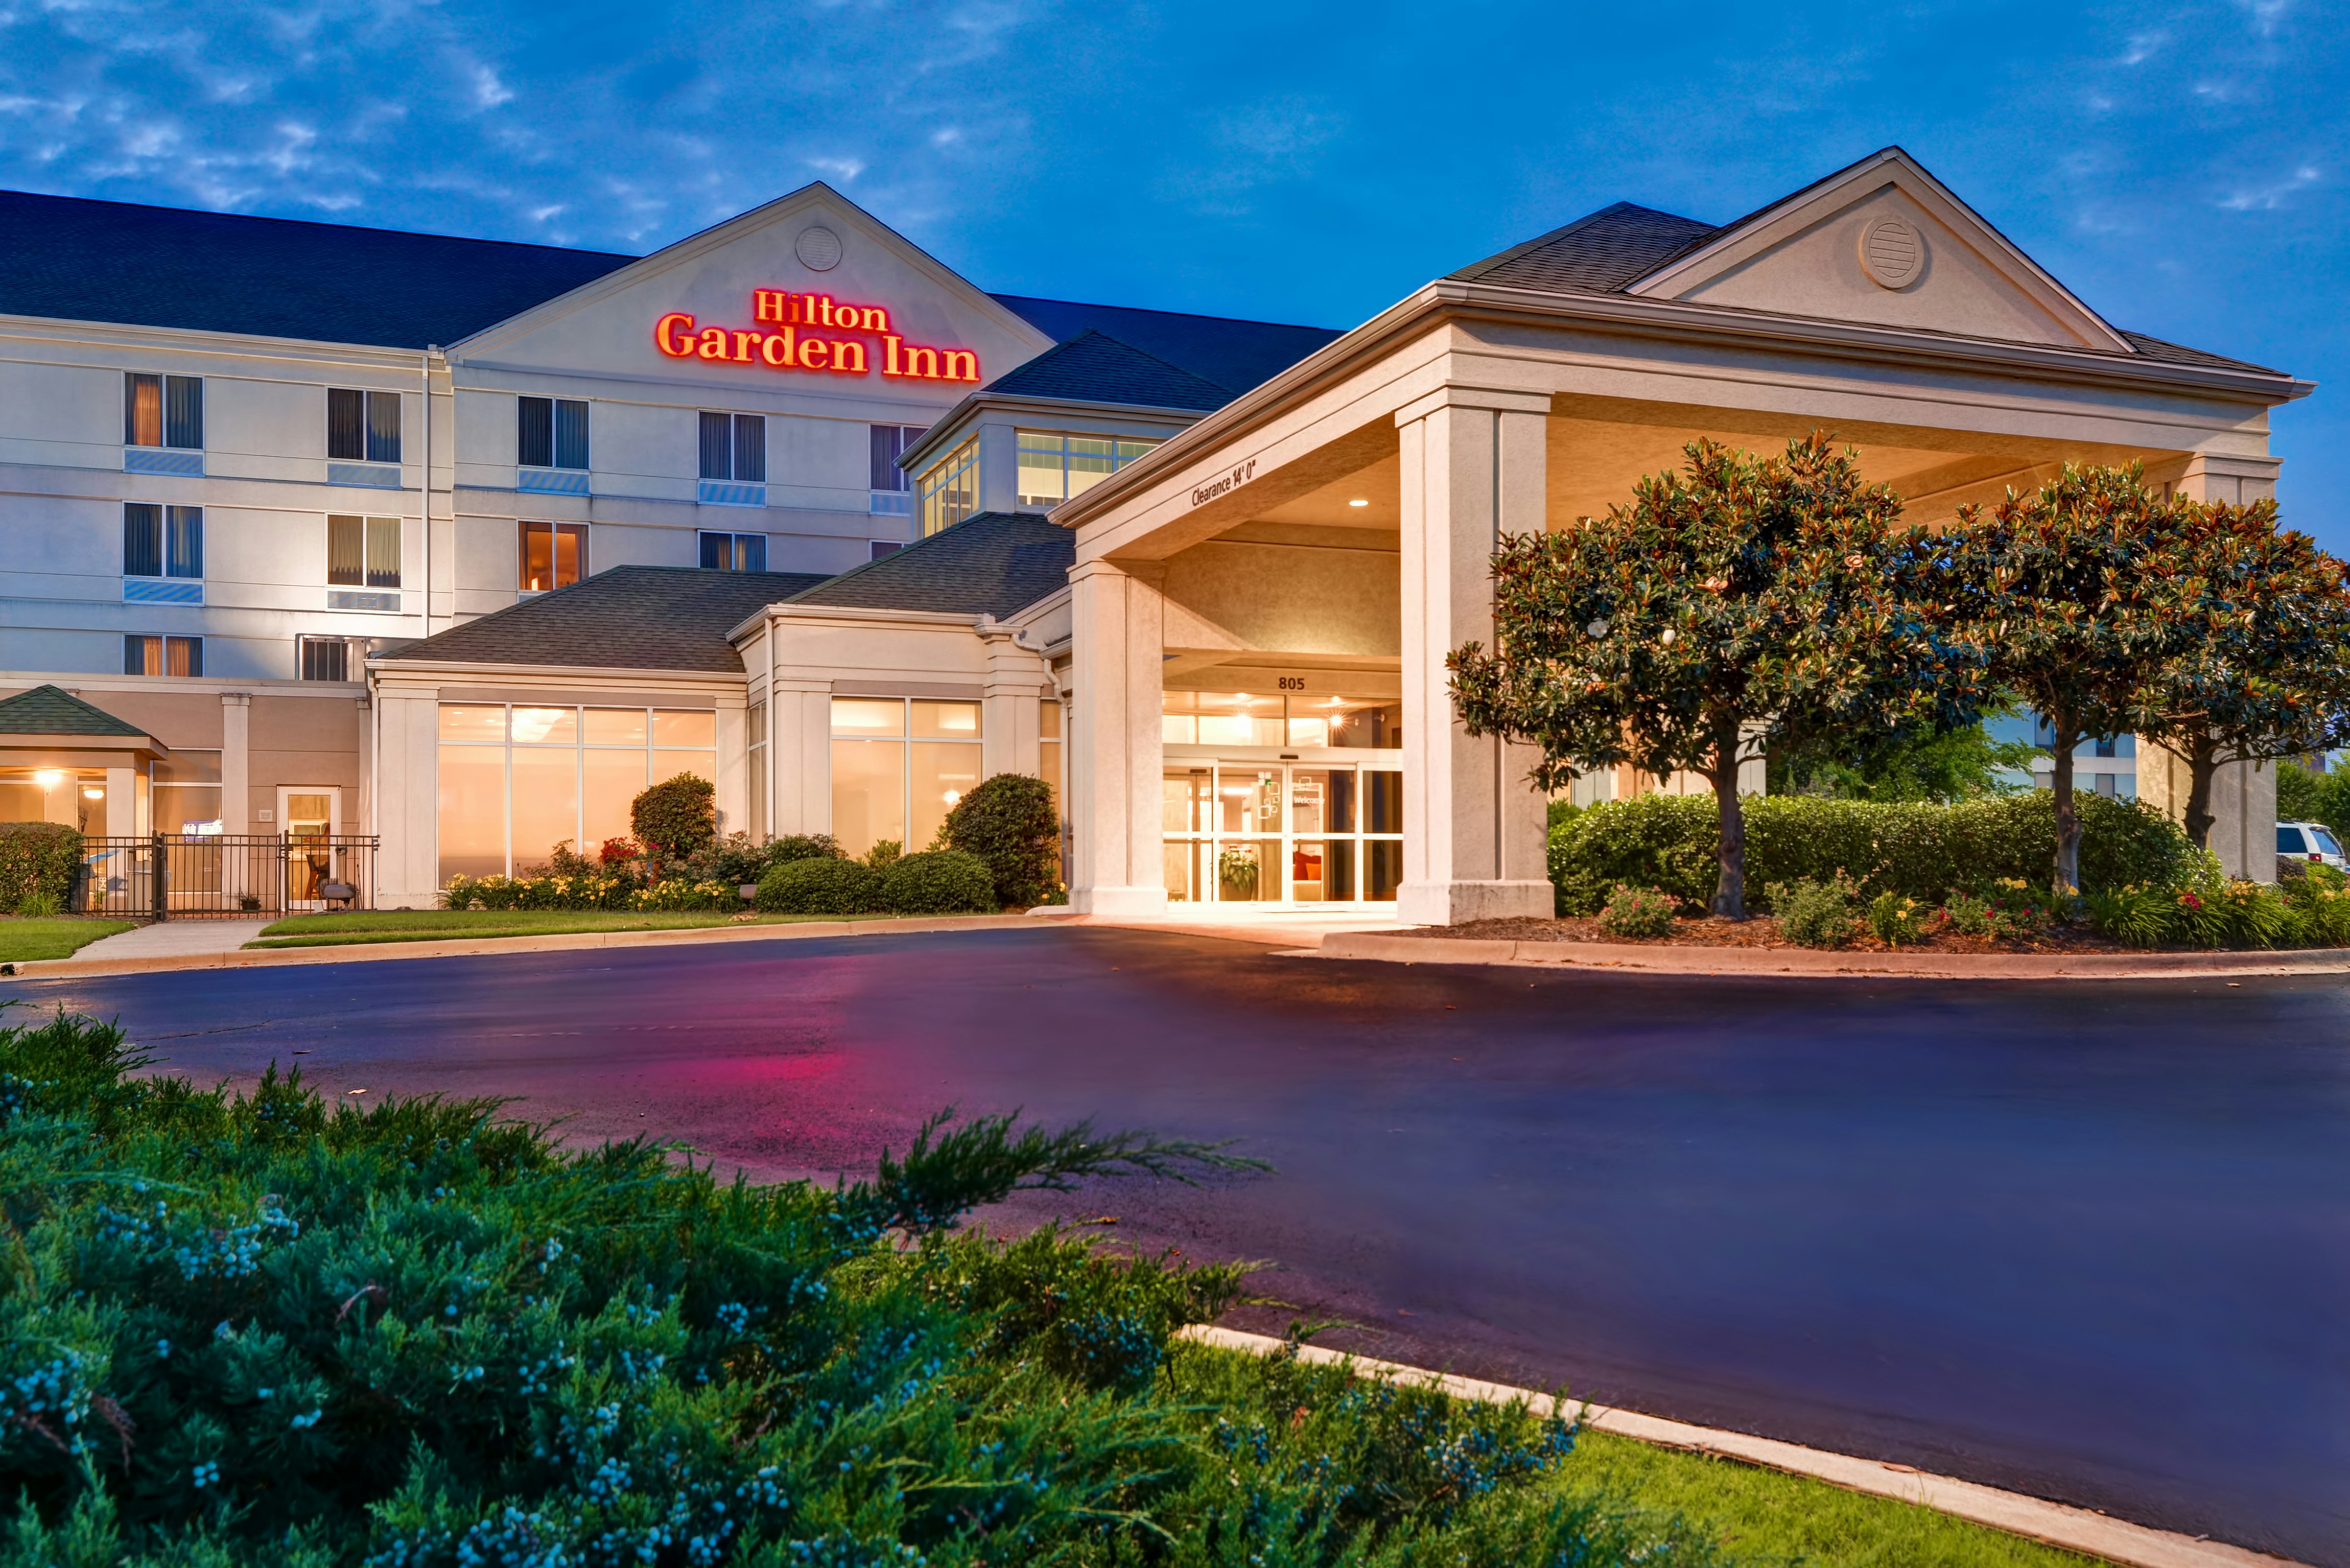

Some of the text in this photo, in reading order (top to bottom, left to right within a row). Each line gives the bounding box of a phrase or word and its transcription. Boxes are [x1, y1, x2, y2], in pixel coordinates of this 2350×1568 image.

[755, 288, 888, 331] Hilton
[657, 314, 980, 381] Garden Inn
[1192, 477, 1231, 506] Clearance
[1233, 465, 1244, 486] 14'
[1279, 677, 1305, 690] 805
